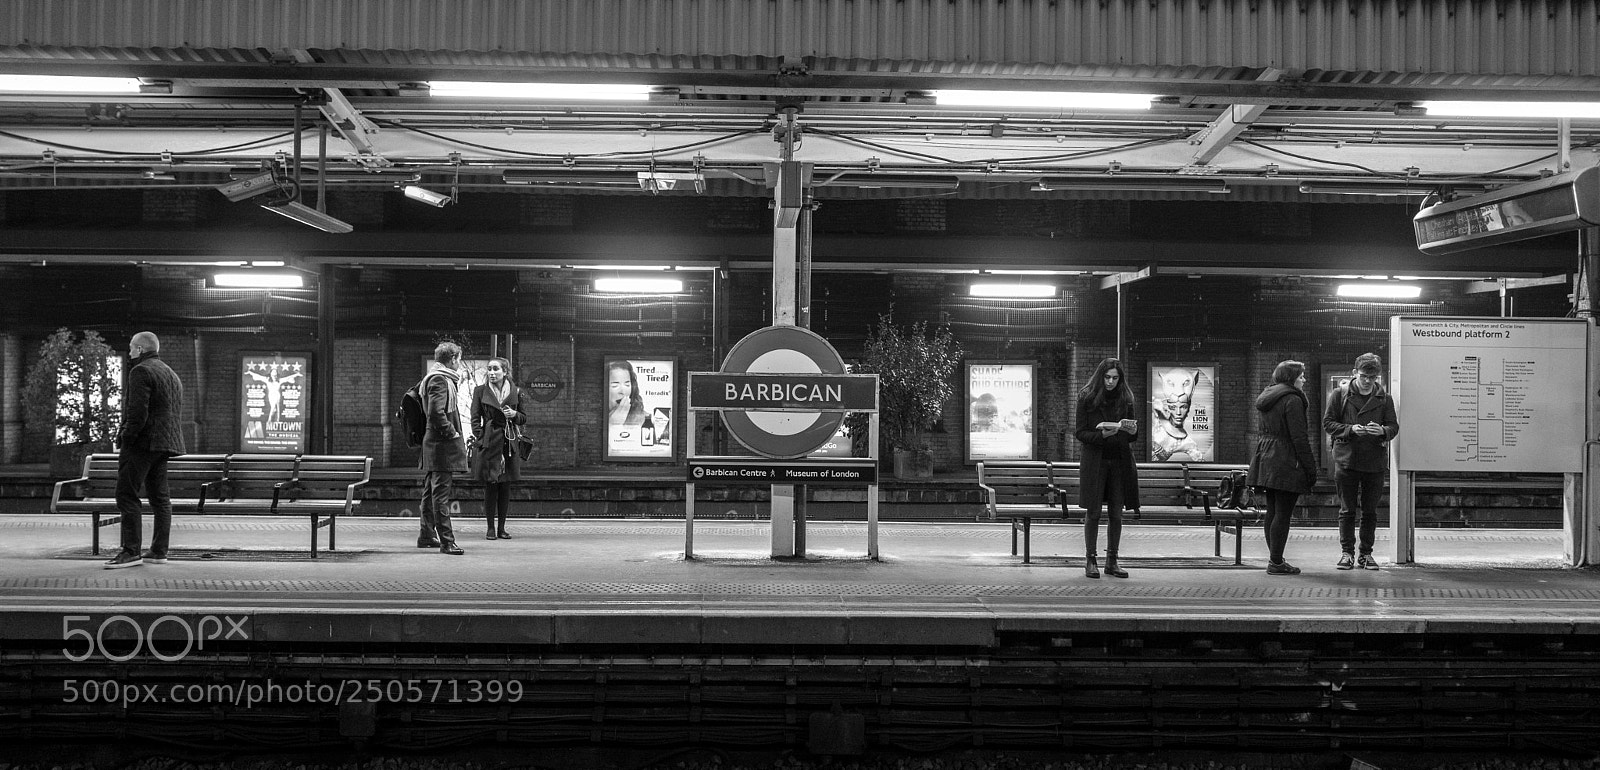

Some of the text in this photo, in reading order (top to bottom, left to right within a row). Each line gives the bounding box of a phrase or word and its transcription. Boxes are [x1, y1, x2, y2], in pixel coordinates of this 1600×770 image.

[1412, 329, 1461, 337] Westbound
[1465, 330, 1503, 339] platform
[725, 383, 842, 402] BARBICAN
[266, 421, 301, 430] MOTOWN
[831, 470, 860, 478] London
